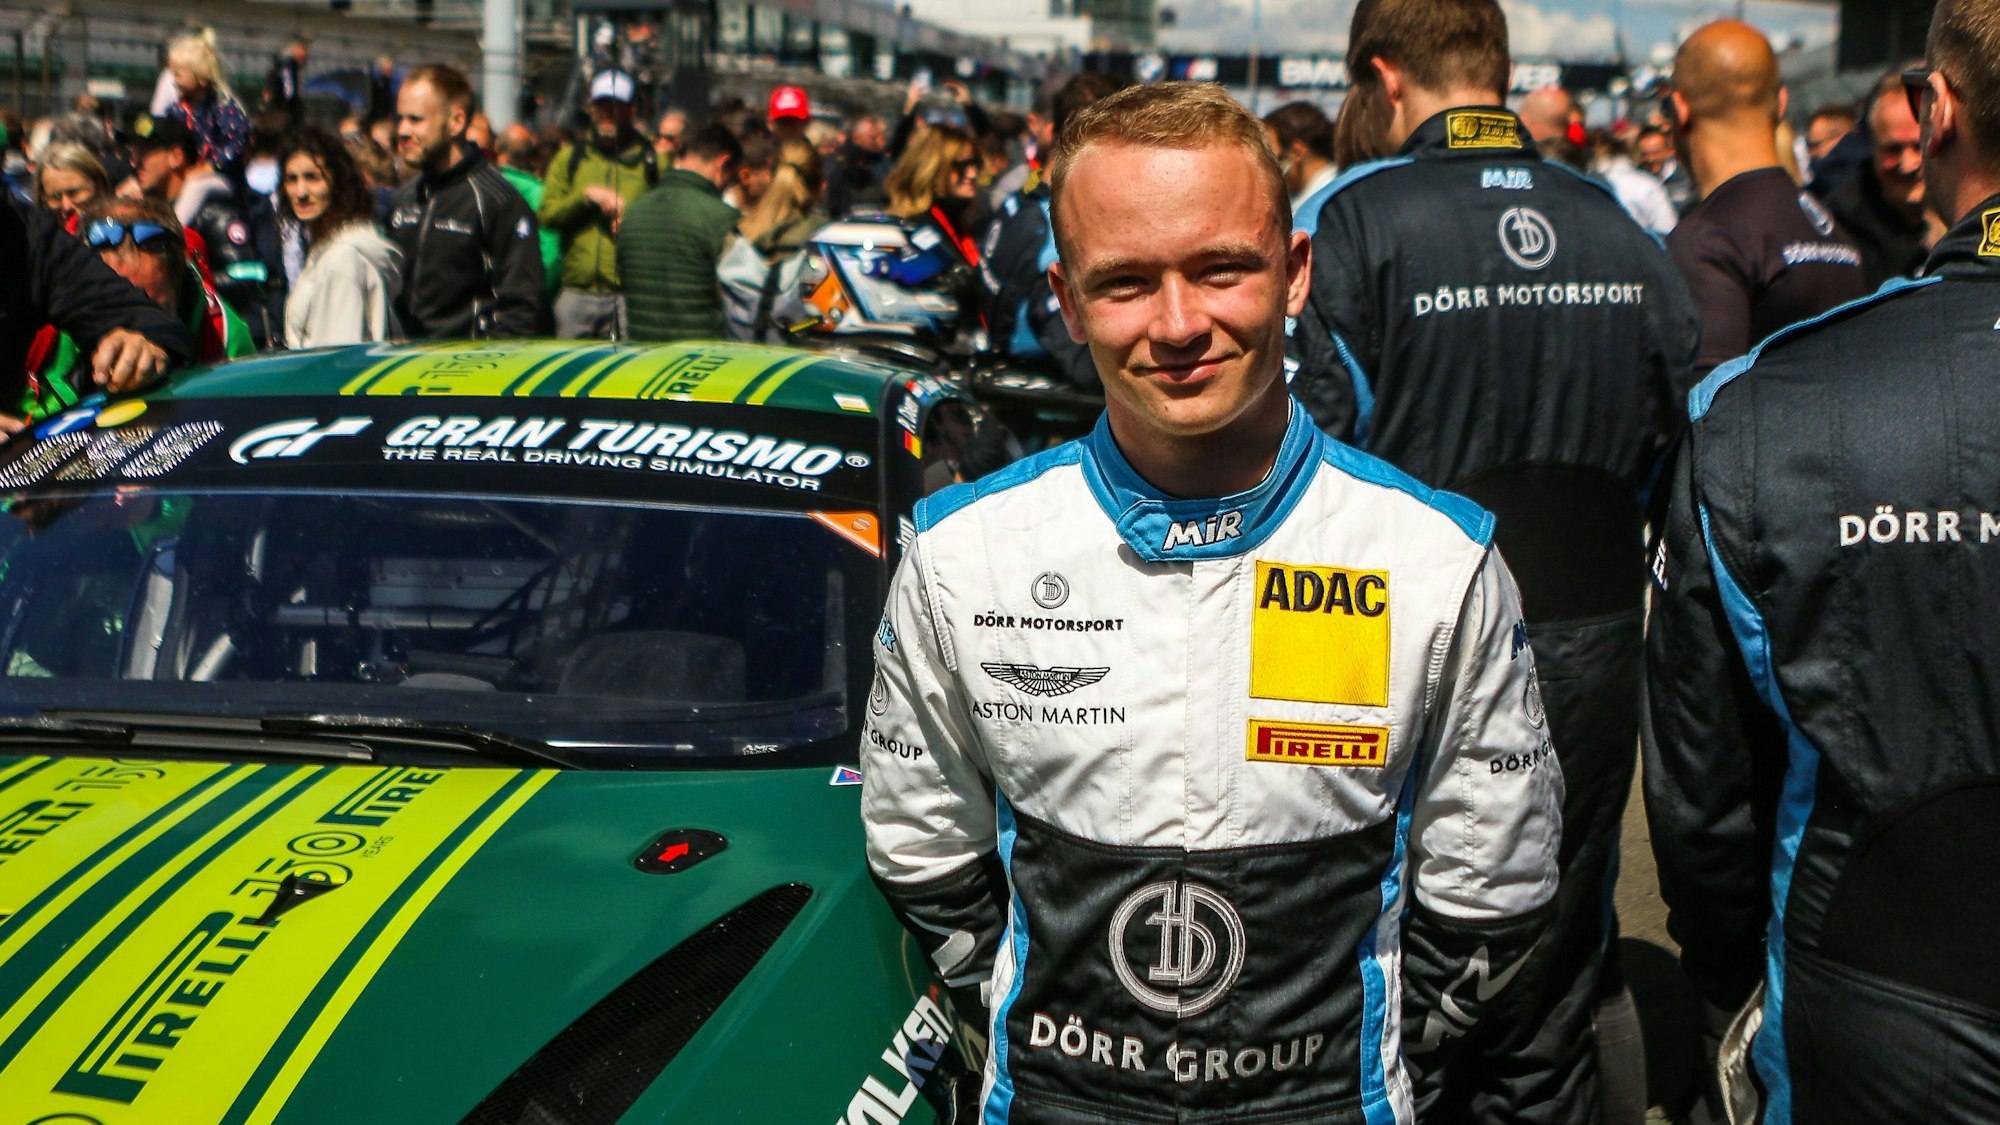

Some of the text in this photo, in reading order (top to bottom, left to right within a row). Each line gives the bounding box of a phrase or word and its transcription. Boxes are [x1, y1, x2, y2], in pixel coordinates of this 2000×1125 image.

[1413, 282, 1645, 317] DÖRR MOTORSPORT
[385, 416, 567, 448] GRAN
[381, 448, 822, 492] THE REAL DRIVING SIMULATOR
[1839, 504, 1962, 547] DÖRR
[1260, 567, 1386, 618] ADAC
[974, 611, 1124, 633] DÖRR MOTORSPORT
[971, 701, 1126, 724] ASTON MARTIN
[870, 729, 923, 761] GROUP
[1256, 726, 1380, 760] PIRELLI
[1490, 748, 1540, 776] DÖRR
[50, 910, 282, 1106] PIRELLI
[1029, 1011, 1324, 1083] DÖRR GROUP
